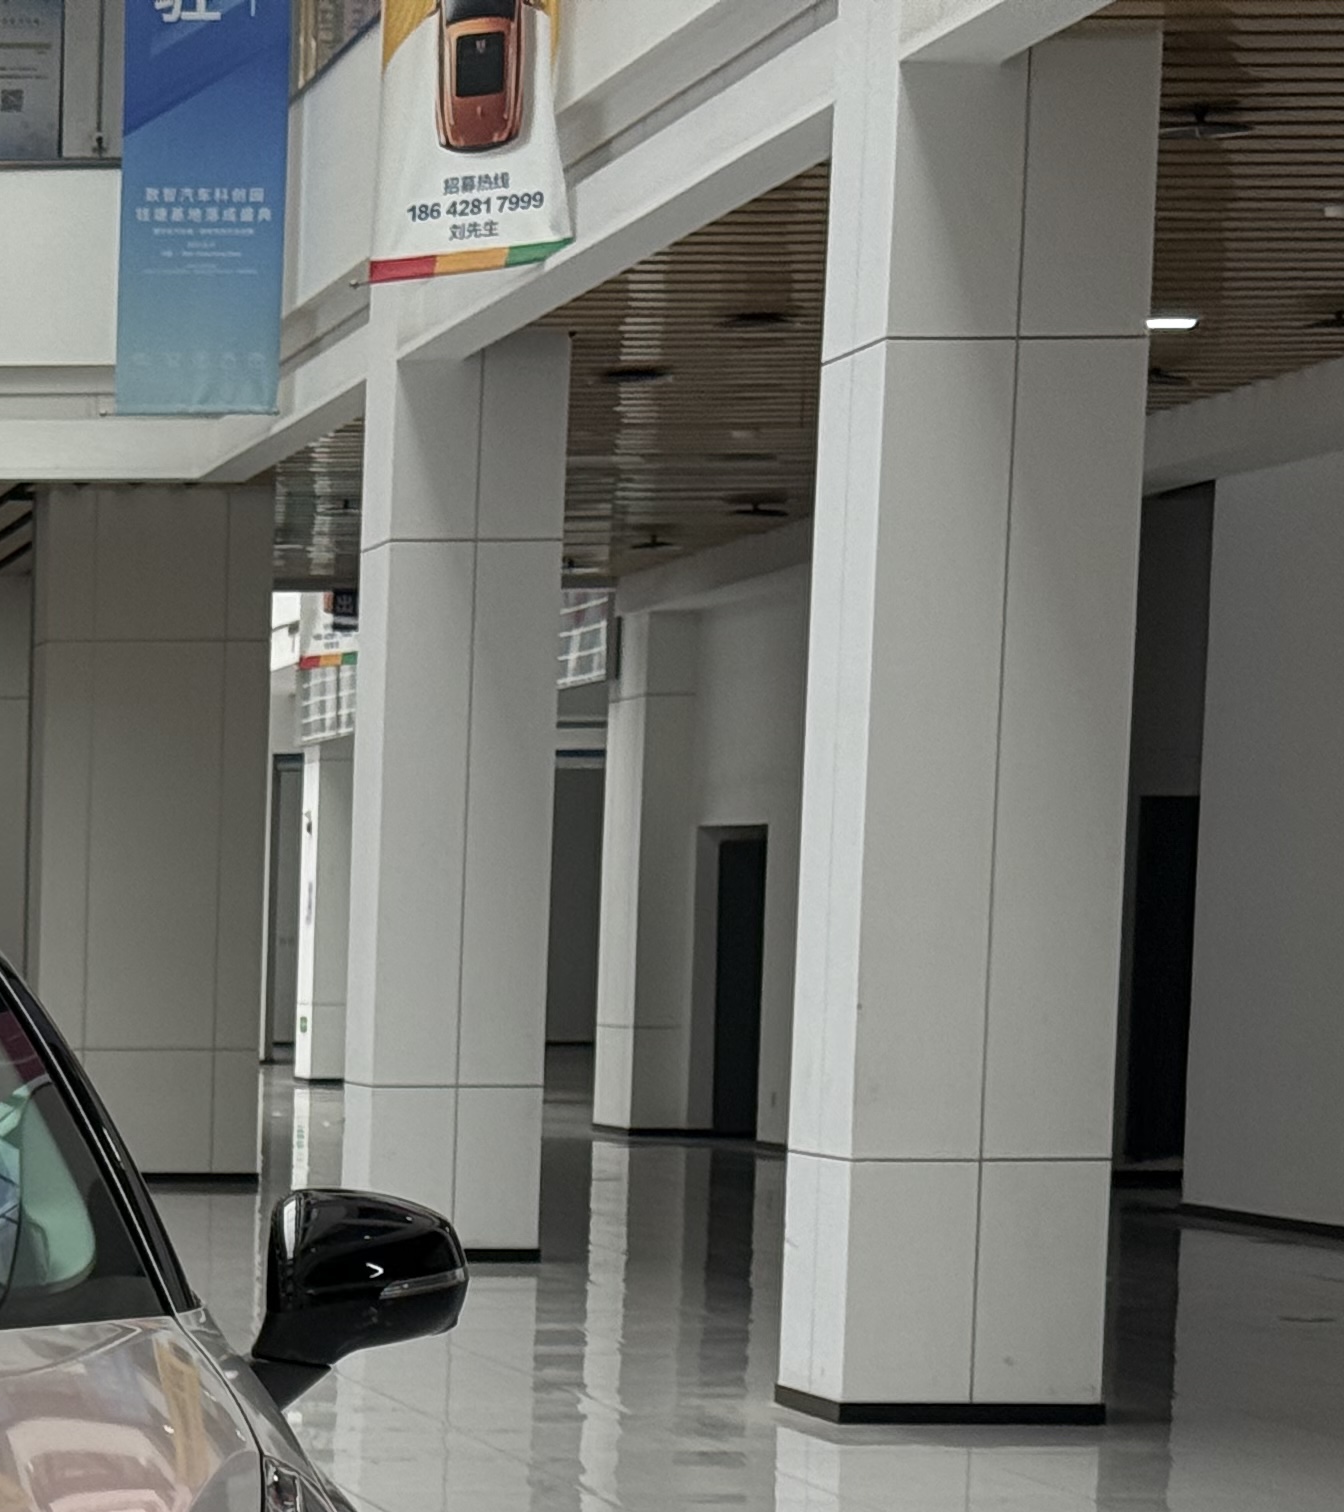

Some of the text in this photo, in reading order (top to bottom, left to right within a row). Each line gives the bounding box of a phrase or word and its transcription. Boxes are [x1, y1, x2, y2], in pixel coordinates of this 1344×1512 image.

[443, 172, 510, 195] 招募热线
[407, 191, 544, 222] 186 4281 7999
[449, 219, 499, 241] 刘先生
